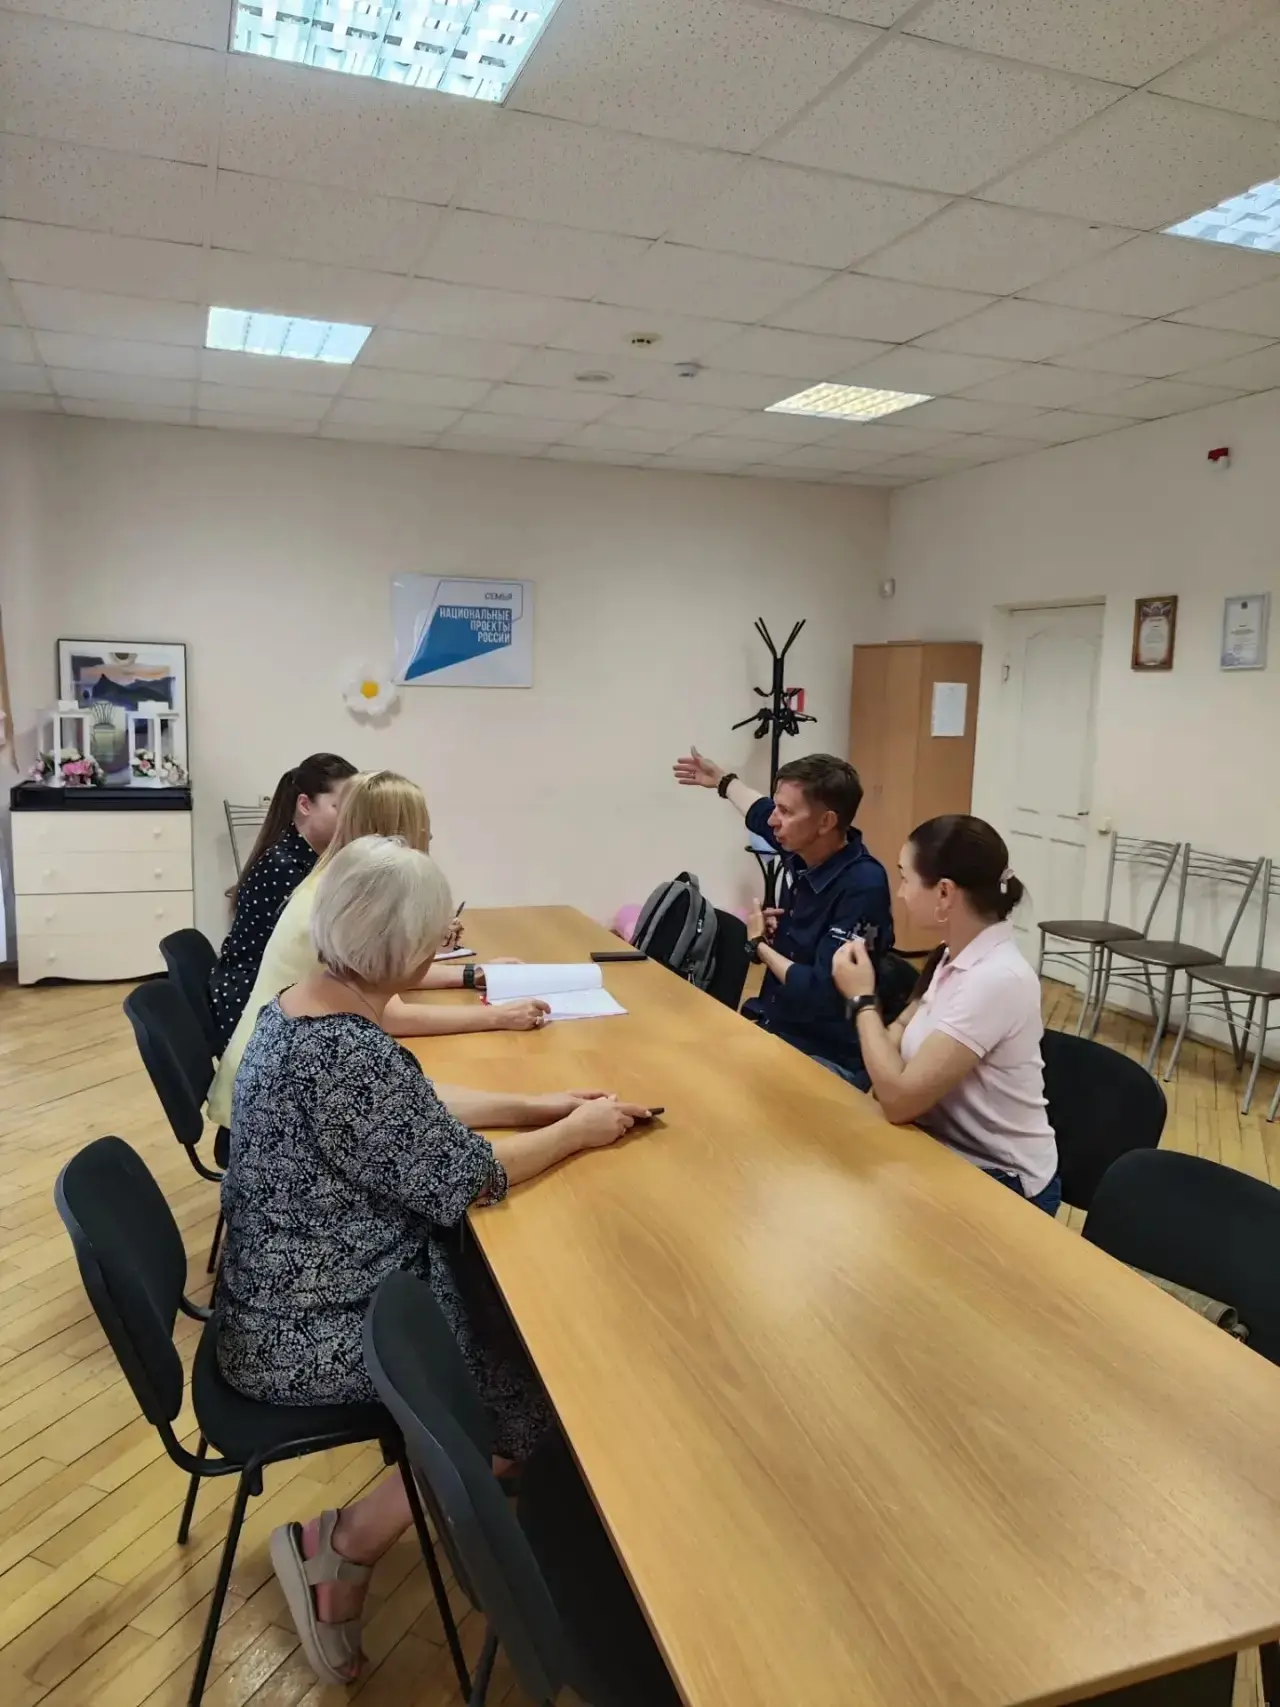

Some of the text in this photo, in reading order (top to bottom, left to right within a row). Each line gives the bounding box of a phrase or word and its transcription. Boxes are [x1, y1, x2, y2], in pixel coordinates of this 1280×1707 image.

[440, 607, 511, 620] НАЦИОНАЛЬНЫЕ
[470, 620, 511, 632] ПРОЕКТЫ
[477, 631, 511, 643] РОССИИ
